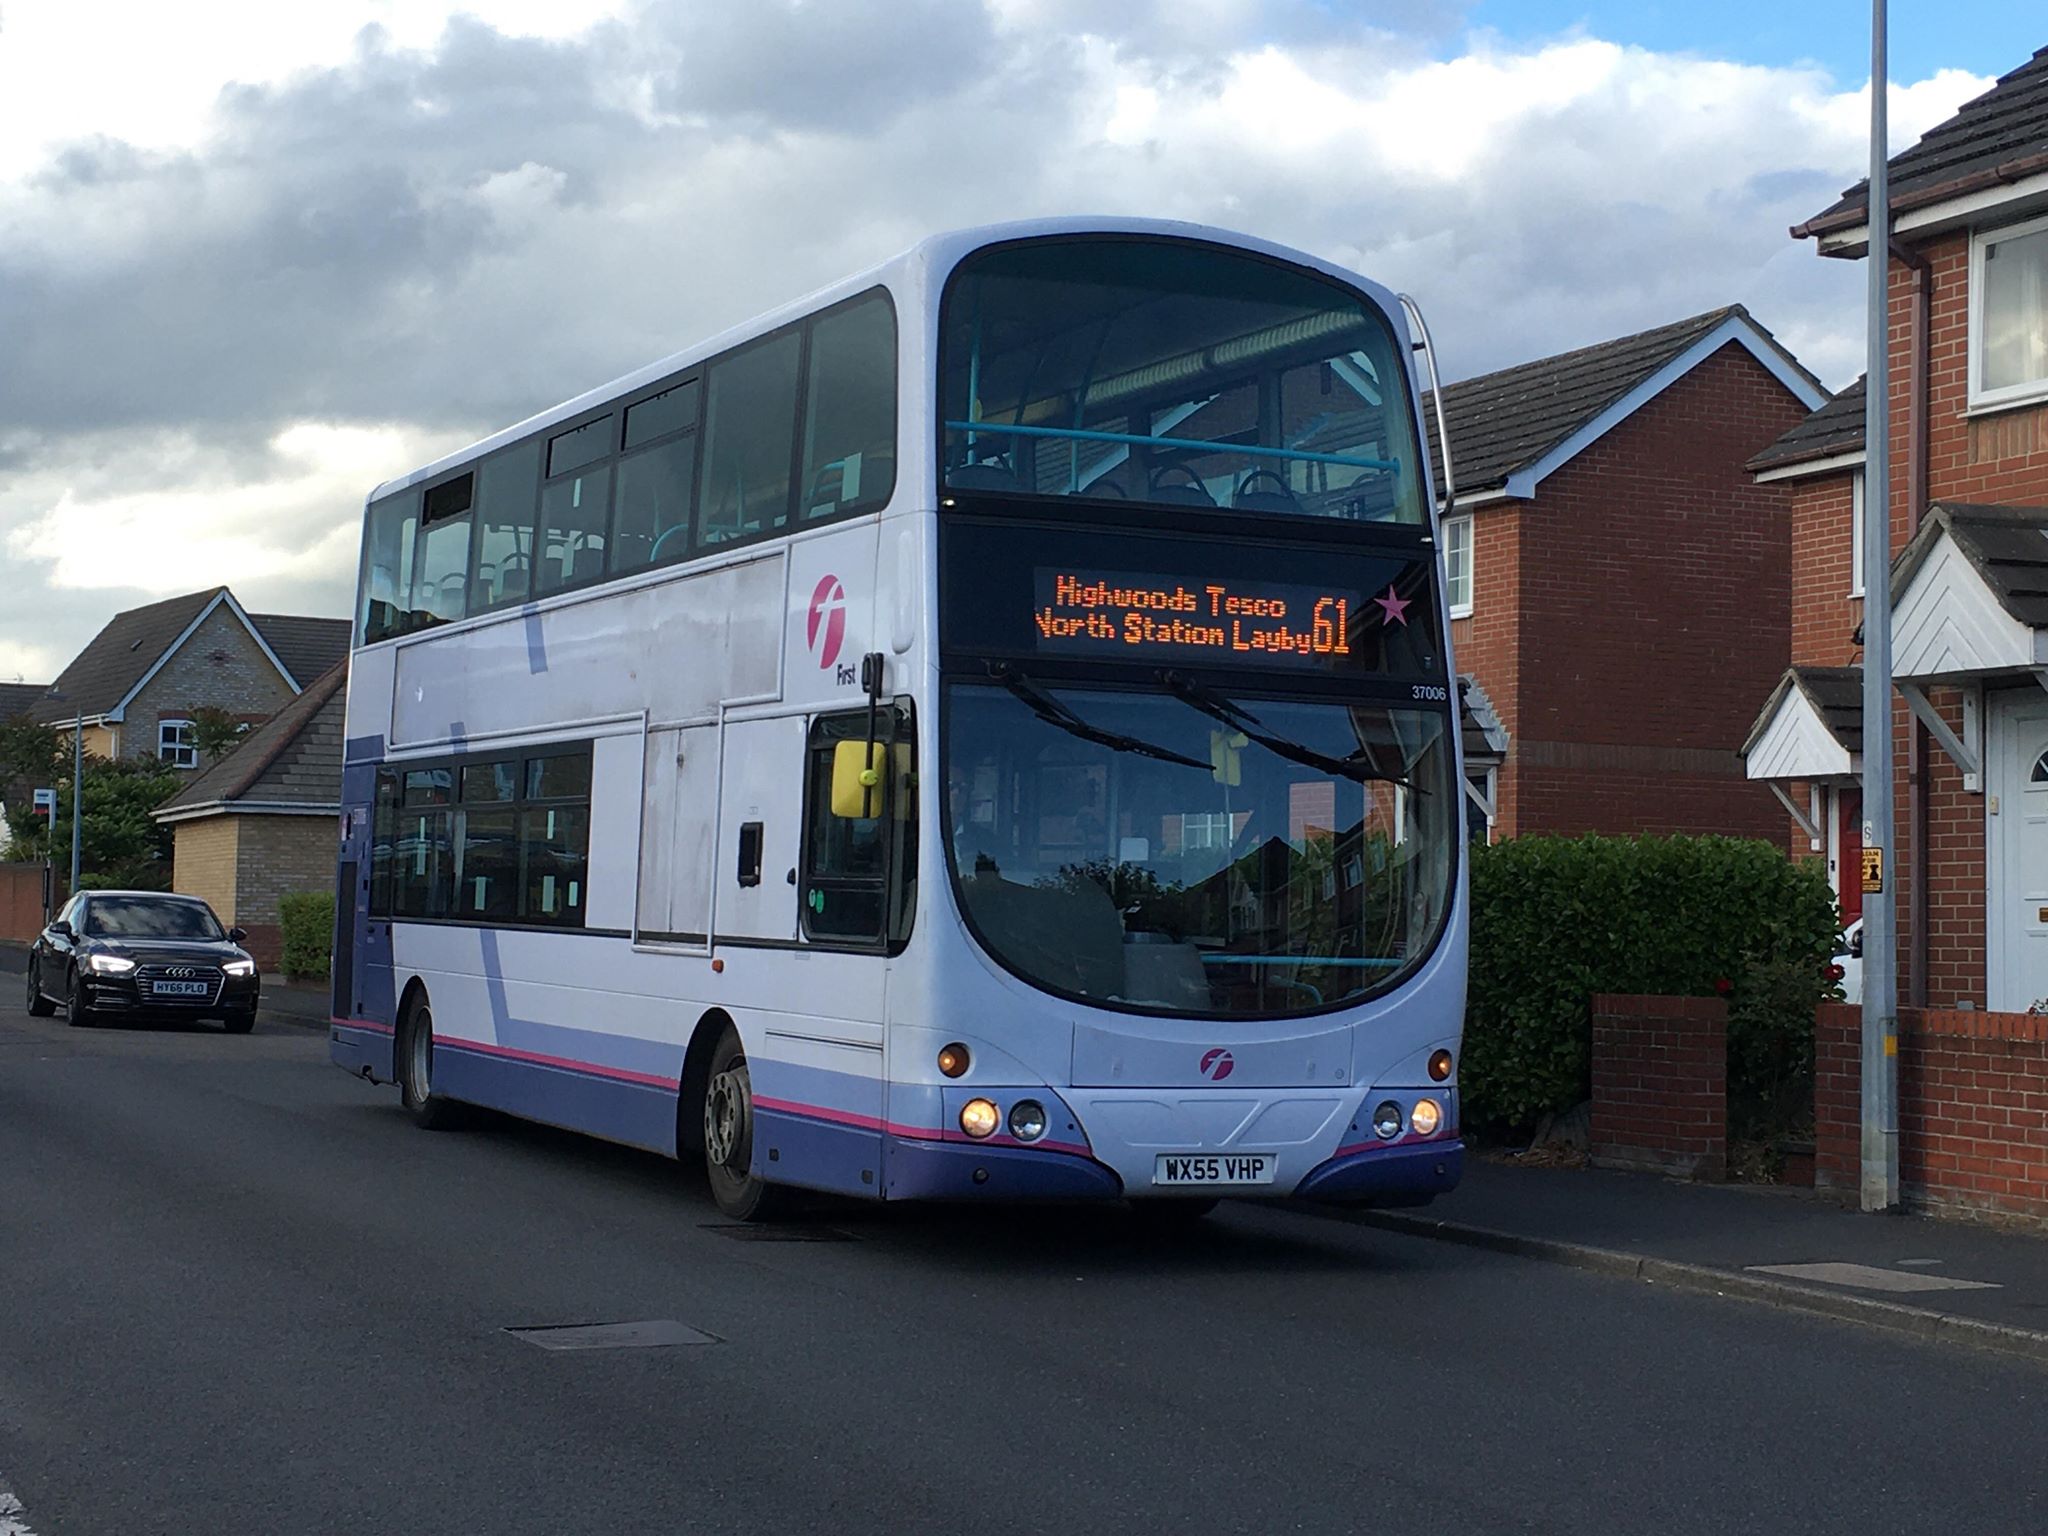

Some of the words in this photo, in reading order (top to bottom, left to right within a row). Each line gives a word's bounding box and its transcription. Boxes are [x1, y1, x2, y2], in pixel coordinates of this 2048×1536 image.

[1056, 575, 1197, 612] Highwoods
[1205, 586, 1286, 617] Tesco
[1123, 612, 1225, 646] Station
[1232, 619, 1311, 654] Layby
[1312, 596, 1350, 655] 61
[836, 663, 856, 686] First
[1412, 684, 1447, 701] 37006
[1166, 1158, 1219, 1181] WX55
[1225, 1158, 1264, 1180] VHP
